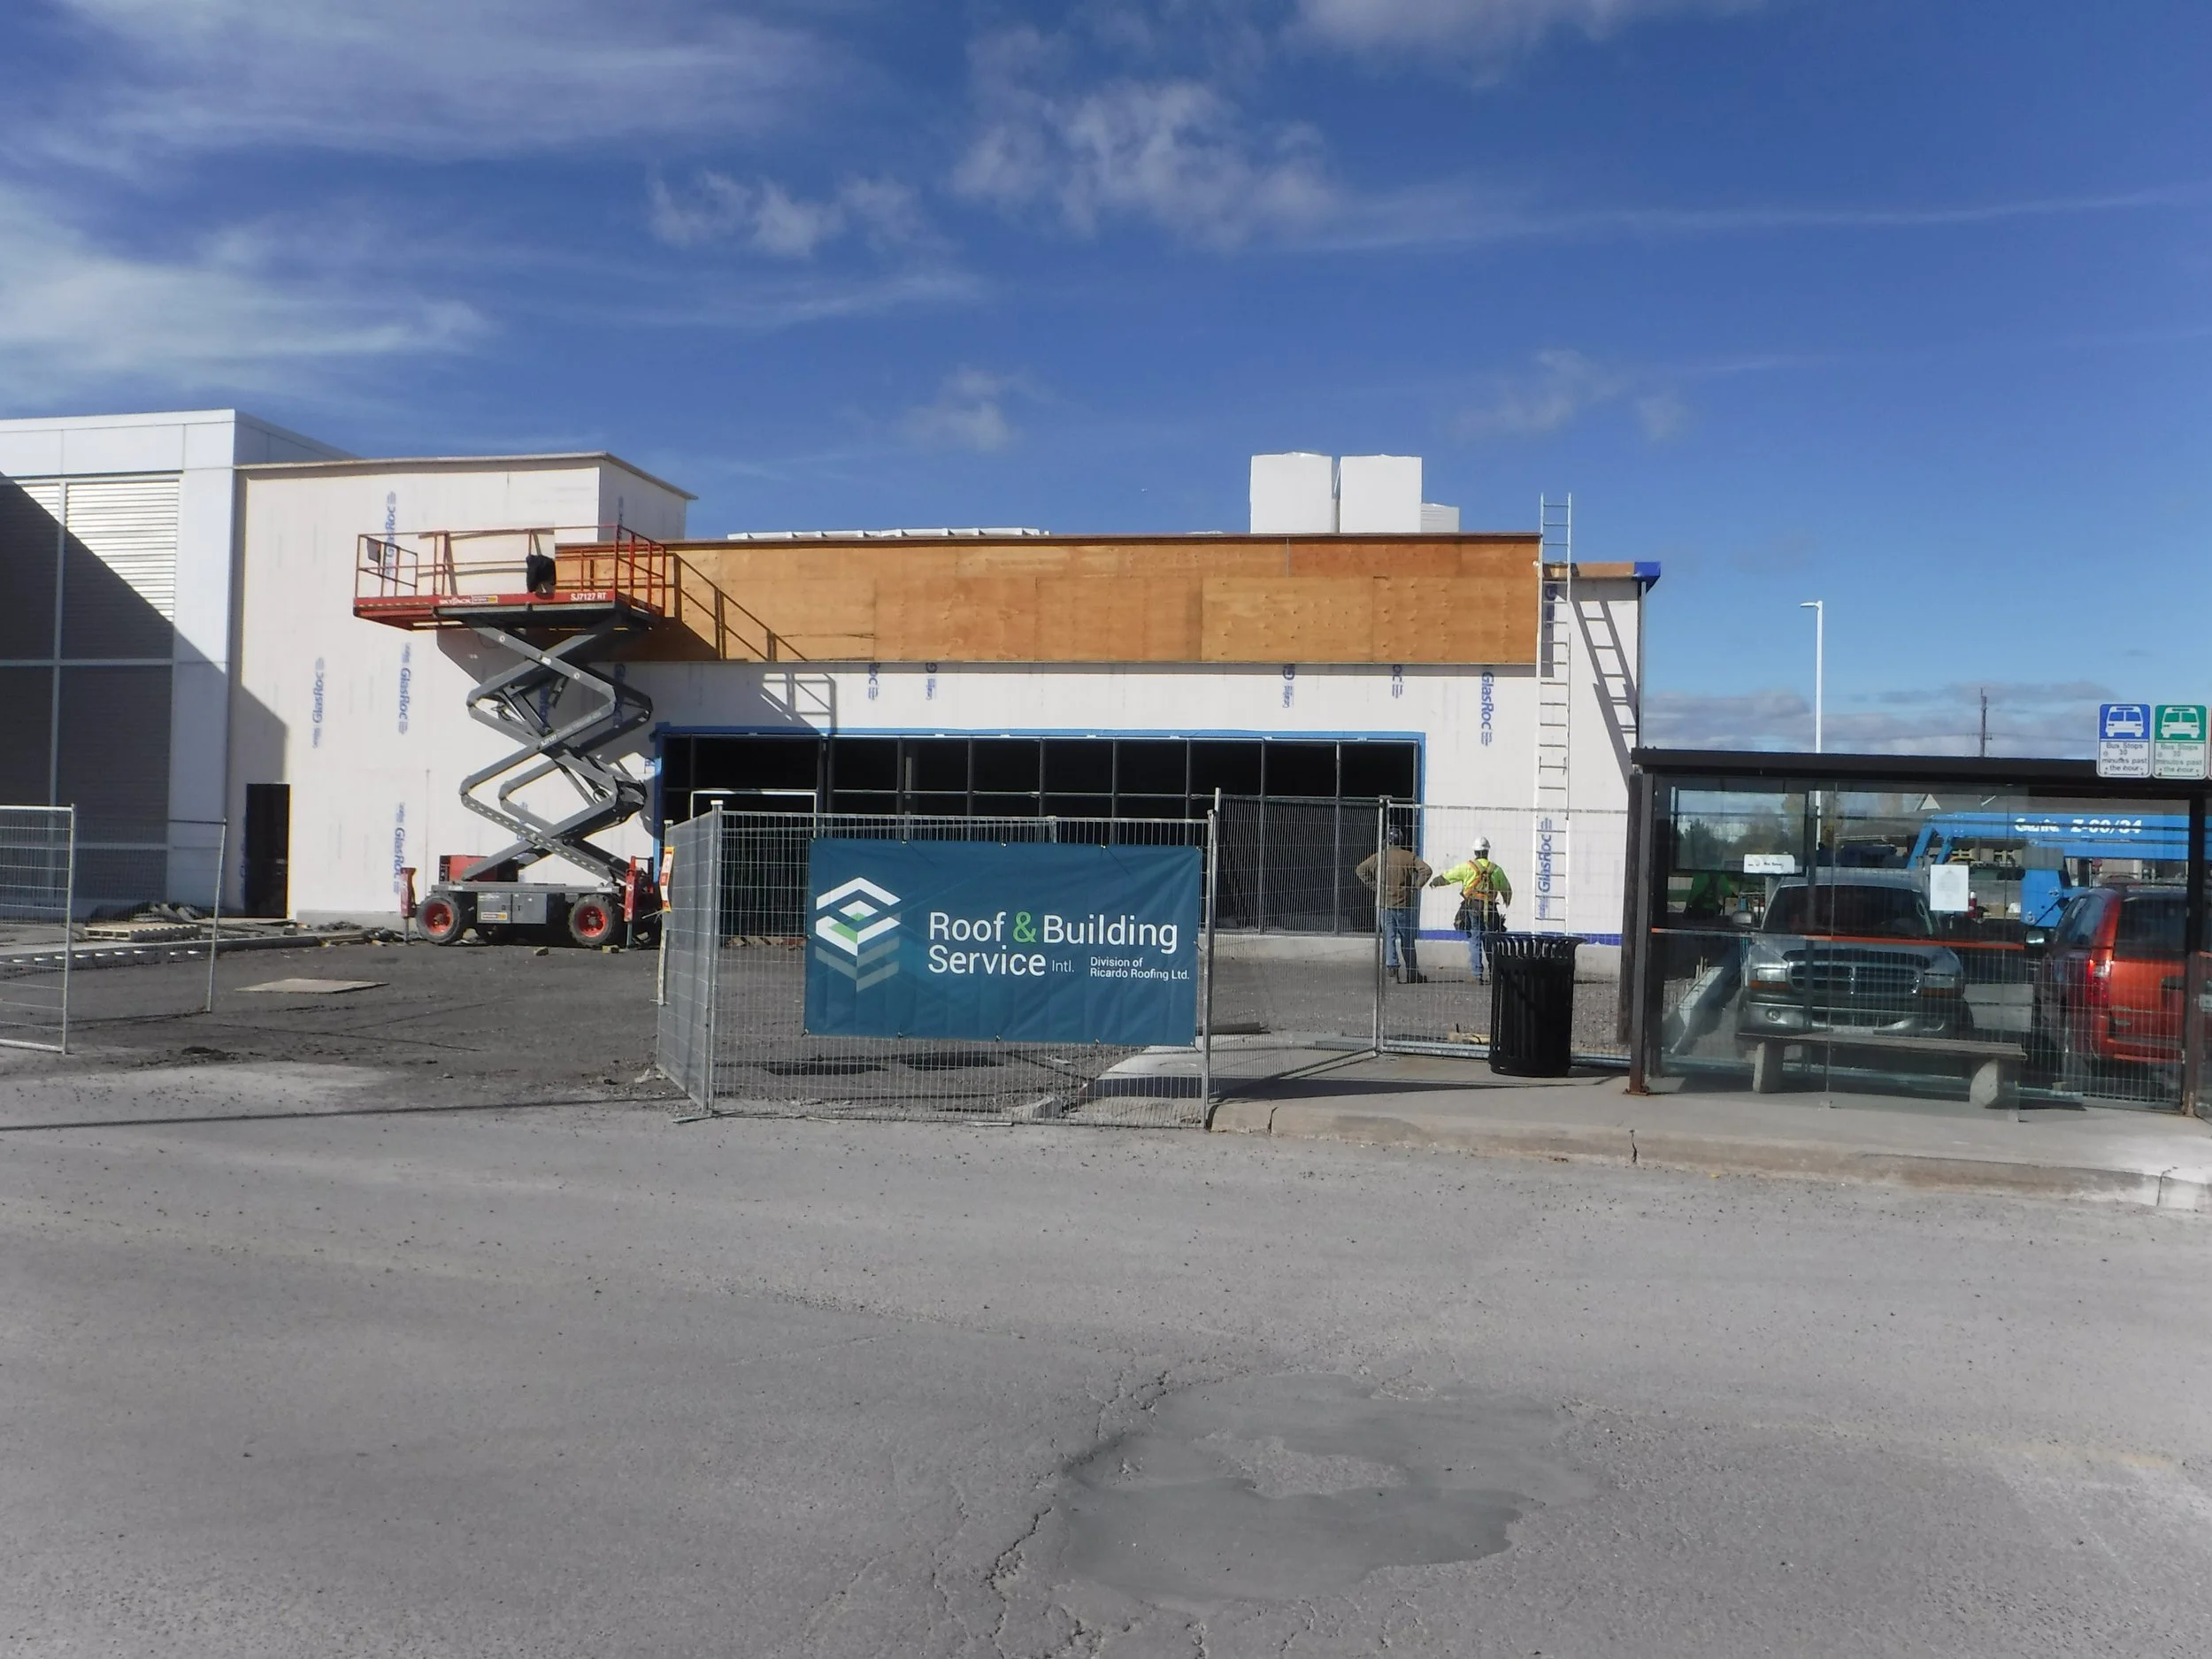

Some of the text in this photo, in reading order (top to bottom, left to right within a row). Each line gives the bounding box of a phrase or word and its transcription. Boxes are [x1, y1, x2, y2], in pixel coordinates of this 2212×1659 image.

[570, 592, 608, 602] SJ7127 RT
[399, 667, 411, 720] GlasRoc
[1481, 672, 1494, 730] GlasRoc
[929, 911, 1178, 955] Roof & Building
[928, 944, 1074, 976] Service Intl.
[1090, 956, 1143, 967] Division of
[1090, 967, 1190, 981] Ricardo Roofing Ltd.
